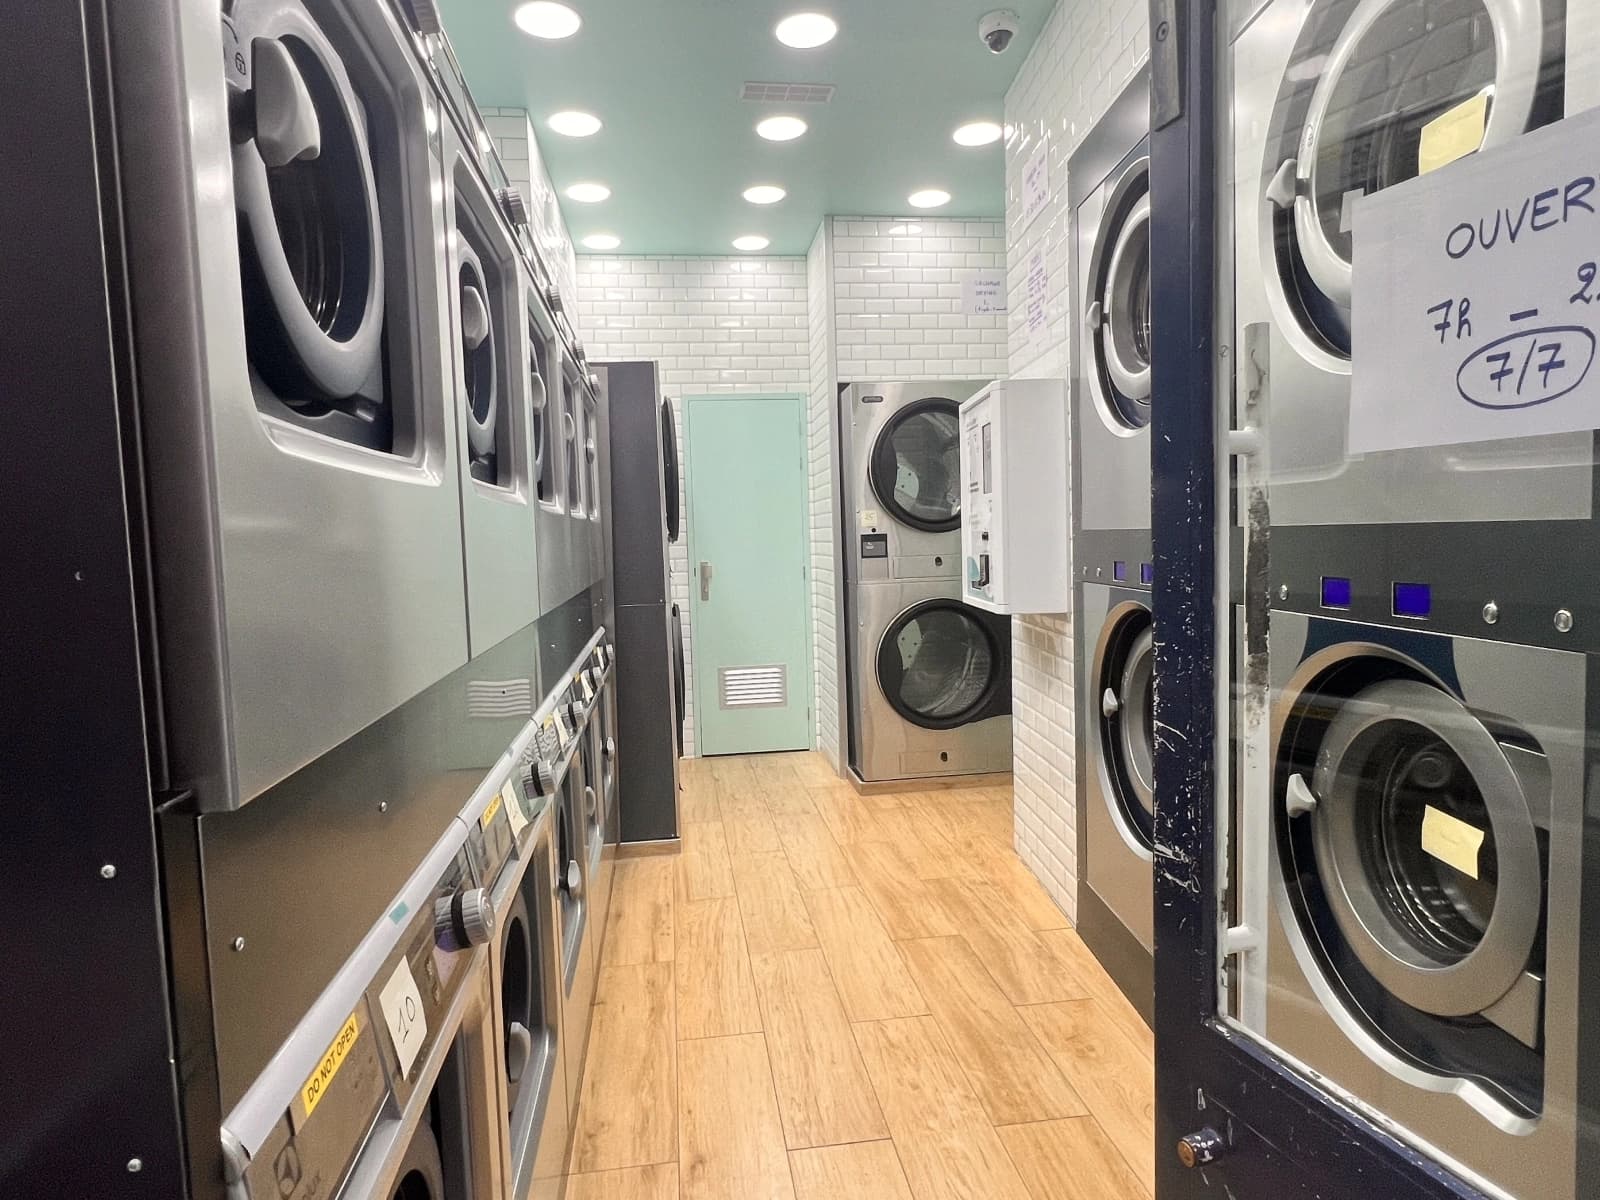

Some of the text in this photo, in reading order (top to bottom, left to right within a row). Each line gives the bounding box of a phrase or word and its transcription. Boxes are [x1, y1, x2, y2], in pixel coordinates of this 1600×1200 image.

[1446, 176, 1600, 259] OUVER
[1570, 262, 1600, 304] 2
[1486, 339, 1565, 395] 7/7
[398, 996, 416, 1044] 10
[307, 1023, 356, 1103] DO NOT OPEN
